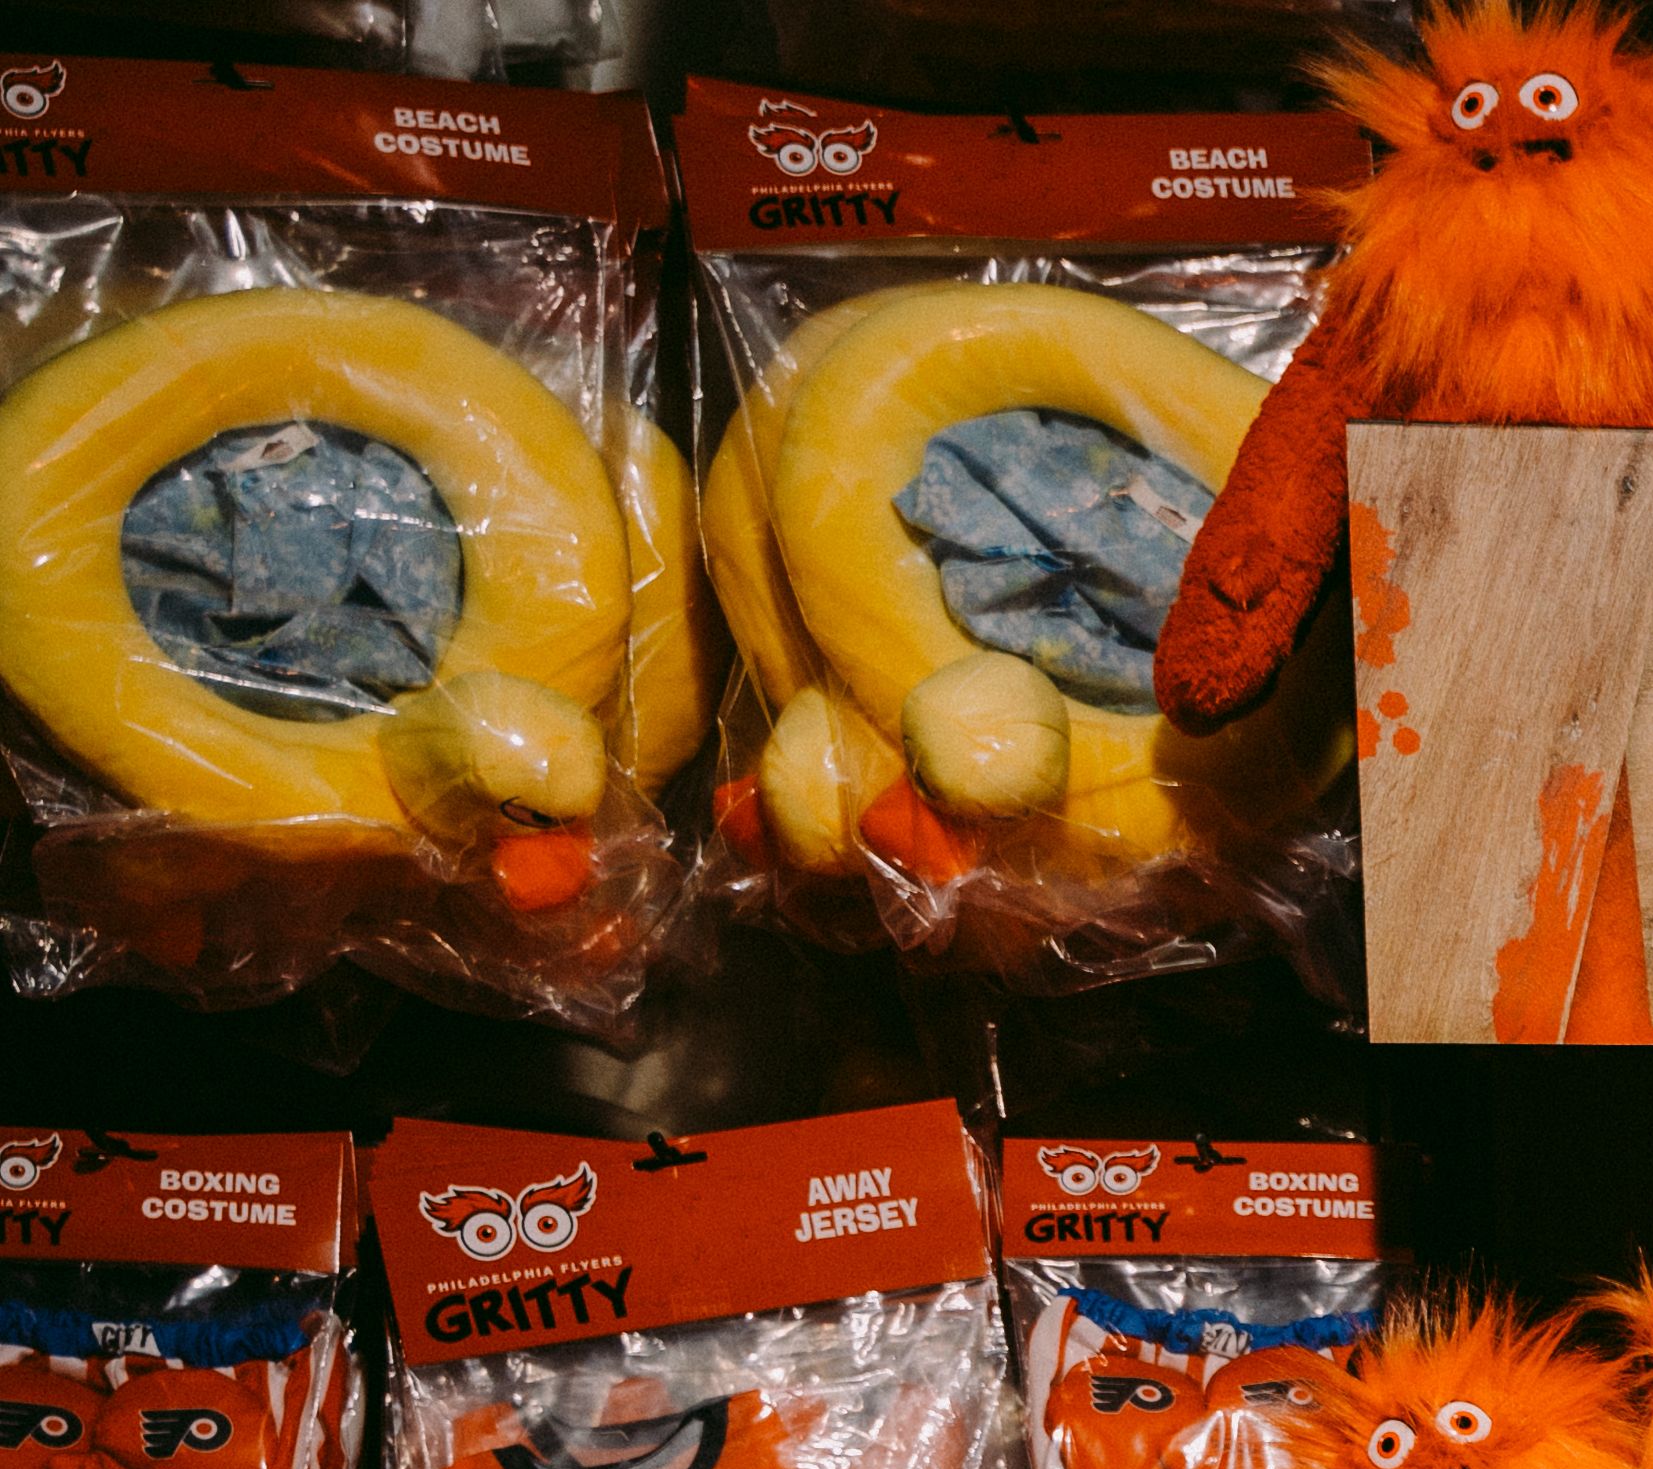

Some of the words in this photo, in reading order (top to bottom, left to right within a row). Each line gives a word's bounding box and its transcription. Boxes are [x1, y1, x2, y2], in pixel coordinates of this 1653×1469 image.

[394, 107, 501, 136] BEACH
[373, 130, 532, 167] COSTUME
[1169, 147, 1268, 170] BEACH
[1150, 176, 1296, 200] COSTUME
[750, 192, 899, 228] GRITTY
[159, 1169, 280, 1195] BOXING
[807, 1167, 893, 1207] AWAY
[1248, 1171, 1360, 1193] BOXING
[141, 1197, 297, 1226] COSTUME
[794, 1198, 919, 1243] JERSEY
[1232, 1196, 1375, 1219] COSTUME
[1025, 1211, 1171, 1243] GRITTY
[427, 1264, 554, 1296] PHILADELPHIA
[560, 1255, 624, 1275] FLYERS
[424, 1266, 633, 1344] GRITTY
